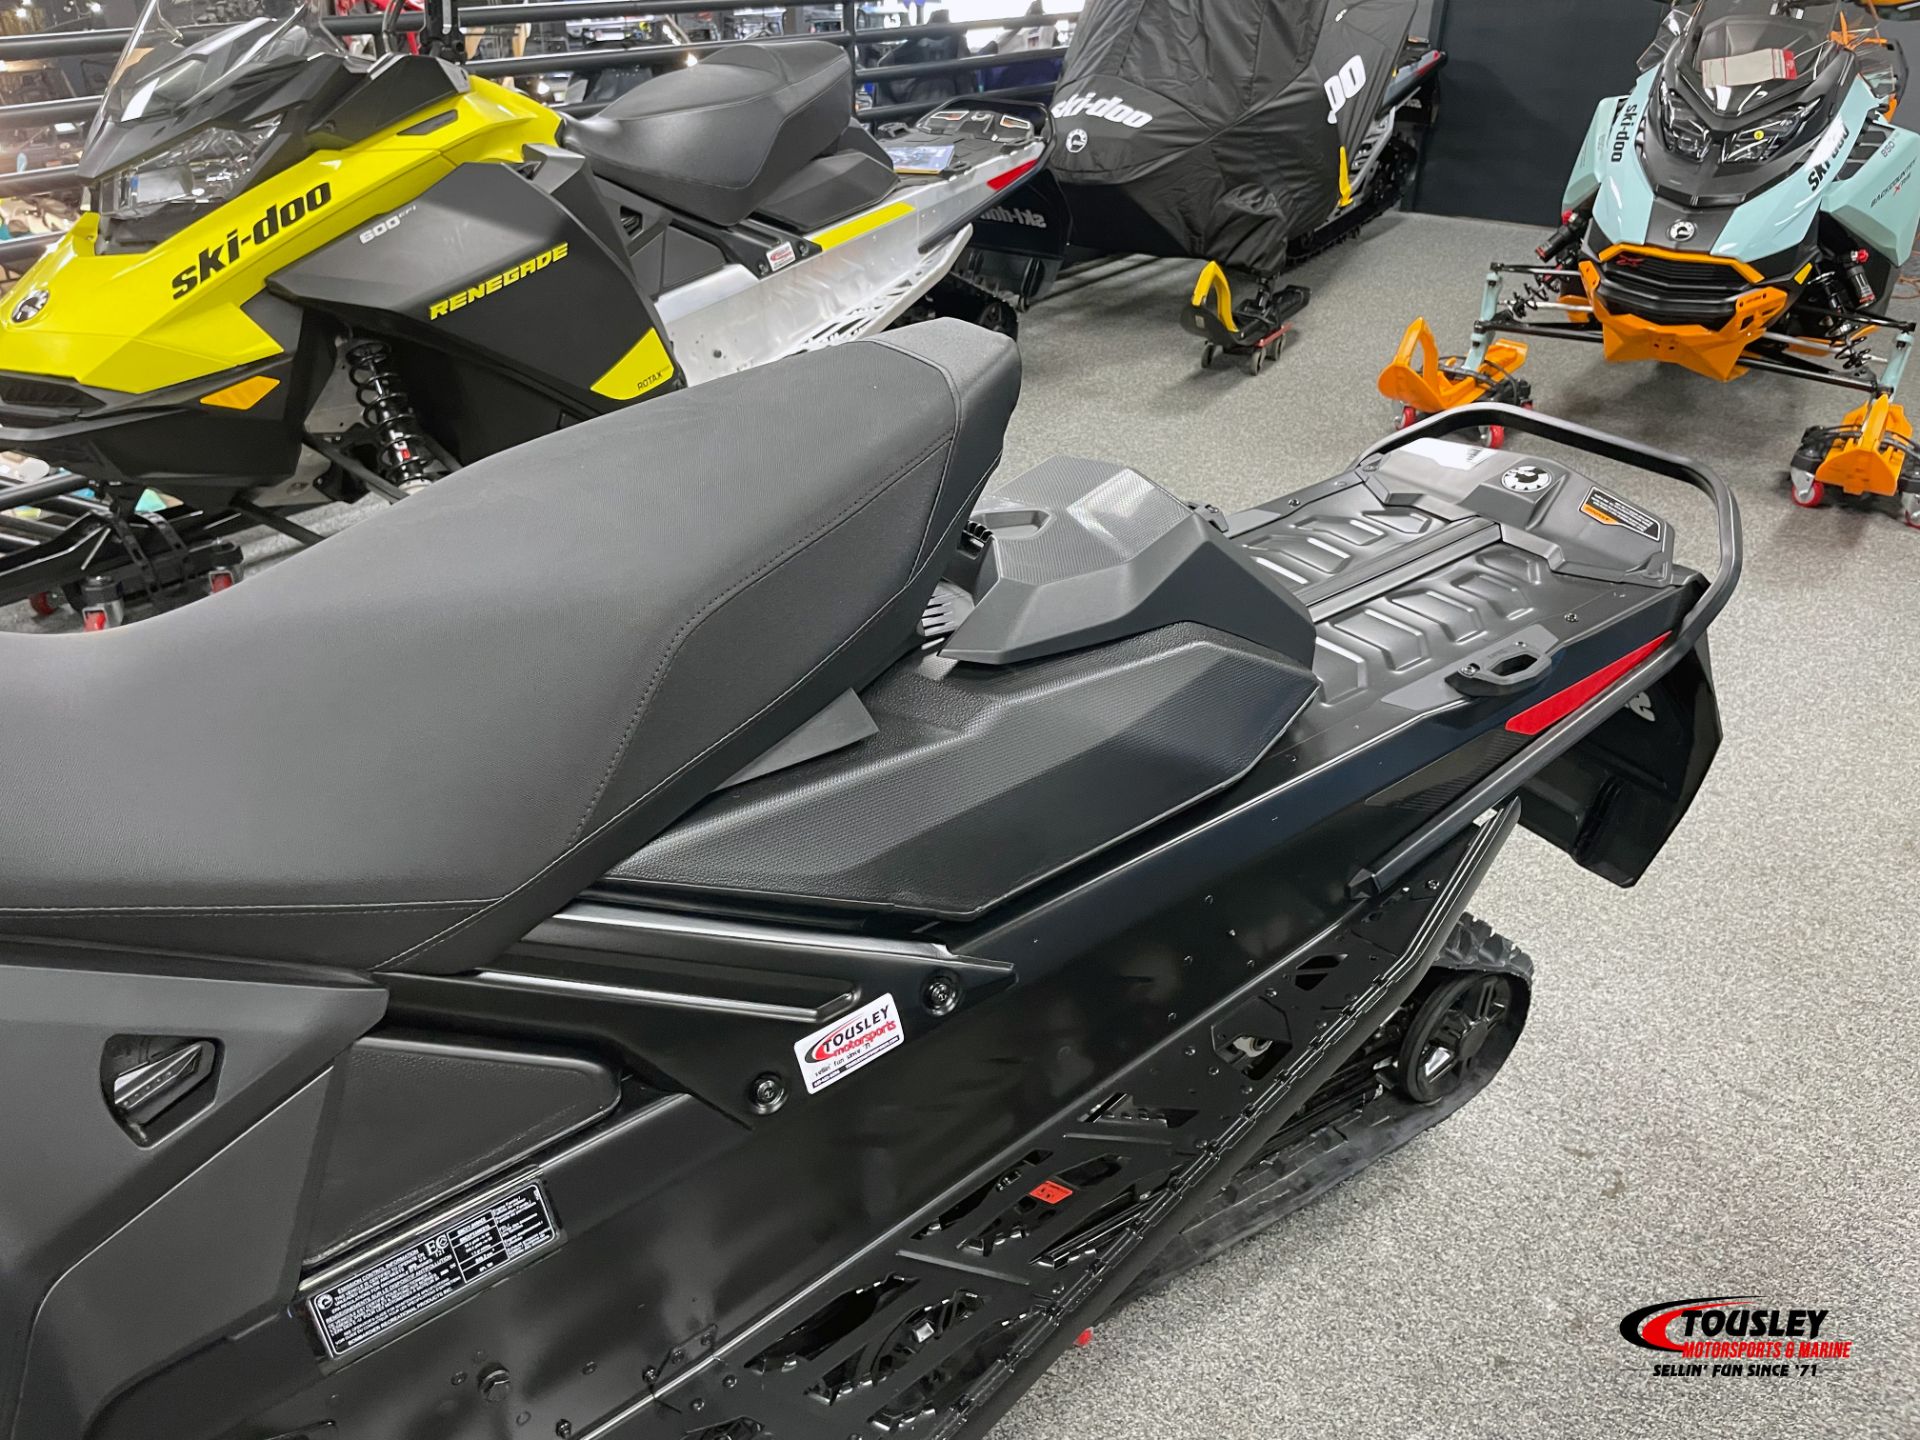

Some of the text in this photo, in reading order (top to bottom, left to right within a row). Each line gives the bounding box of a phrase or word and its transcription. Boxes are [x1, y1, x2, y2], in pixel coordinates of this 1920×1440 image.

[1610, 103, 1638, 163] ski-doo
[171, 181, 332, 301] ski-doo
[359, 215, 401, 245] 600
[428, 241, 569, 321] RENEGADE
[637, 371, 663, 391] ROTAX
[823, 1005, 890, 1053] TOUSLEY
[833, 1020, 897, 1056] motorsports
